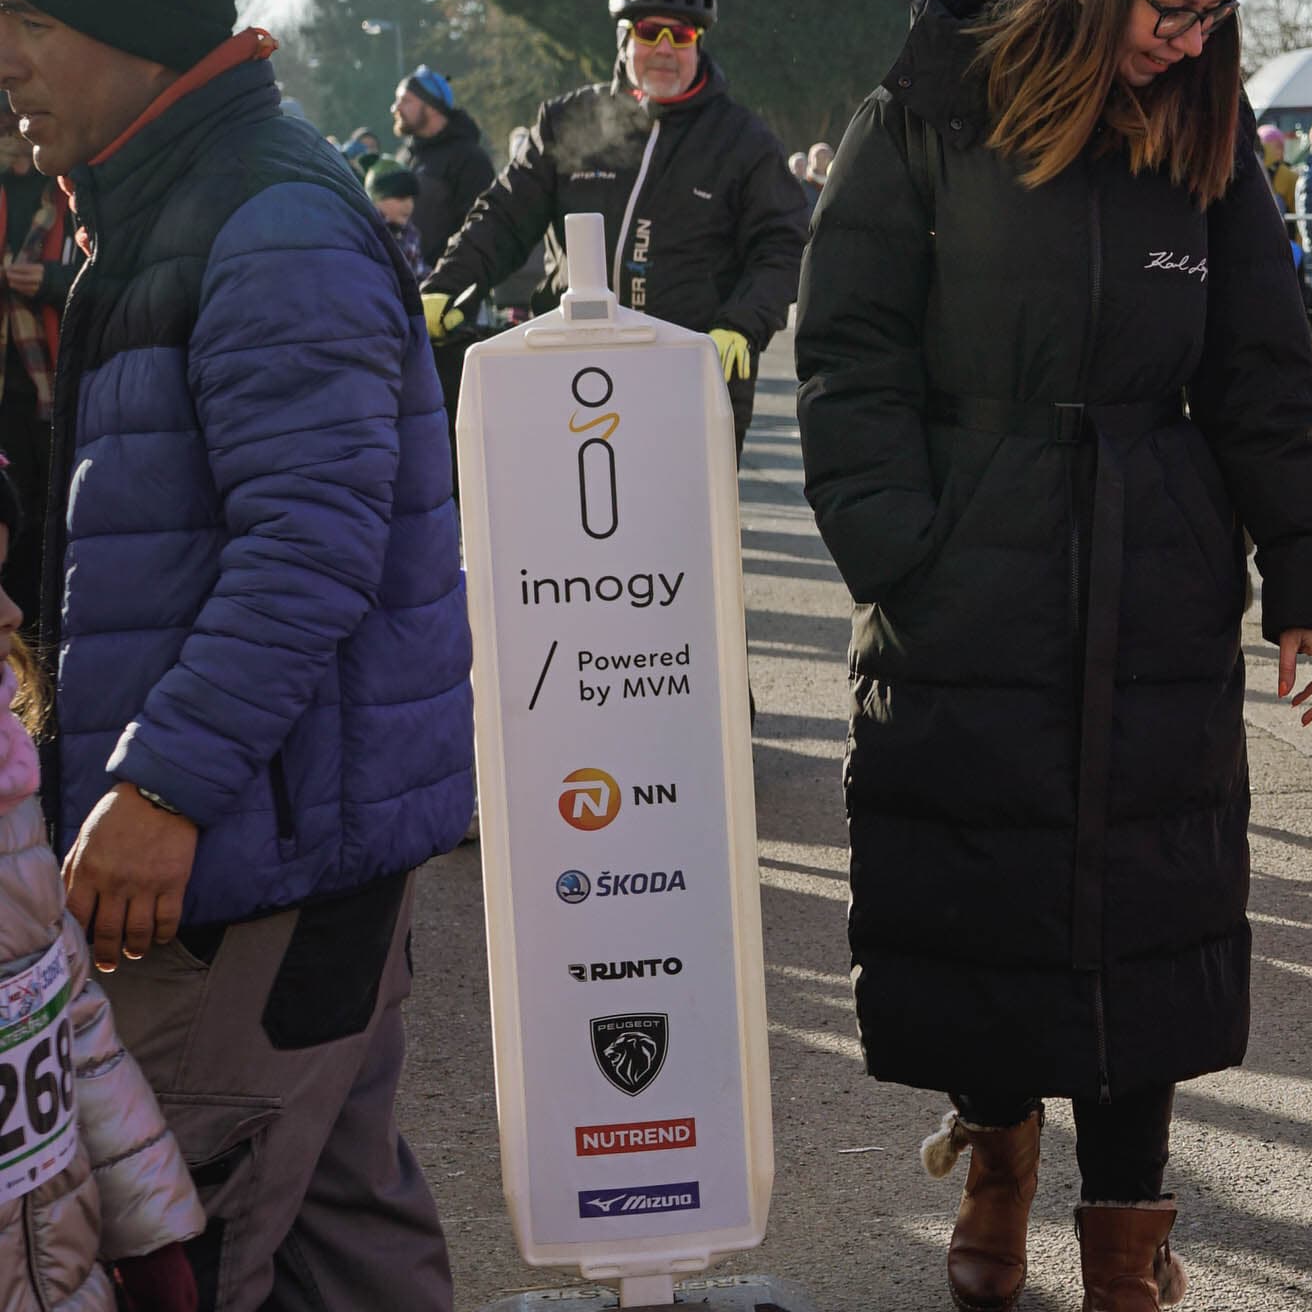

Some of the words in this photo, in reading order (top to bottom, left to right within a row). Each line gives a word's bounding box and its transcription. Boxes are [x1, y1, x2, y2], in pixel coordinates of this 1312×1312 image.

[633, 218, 652, 262] RUN
[520, 569, 685, 608] innogy
[578, 644, 690, 671] Powered
[580, 680, 611, 707] by
[623, 675, 691, 699] MVM
[632, 783, 677, 806] NN
[596, 870, 687, 896] ŠKODA
[590, 957, 682, 981] RUNTO
[597, 1019, 661, 1032] PEUGEOT
[582, 1125, 691, 1150] NUTREND
[620, 1193, 692, 1211] MIZUNO
